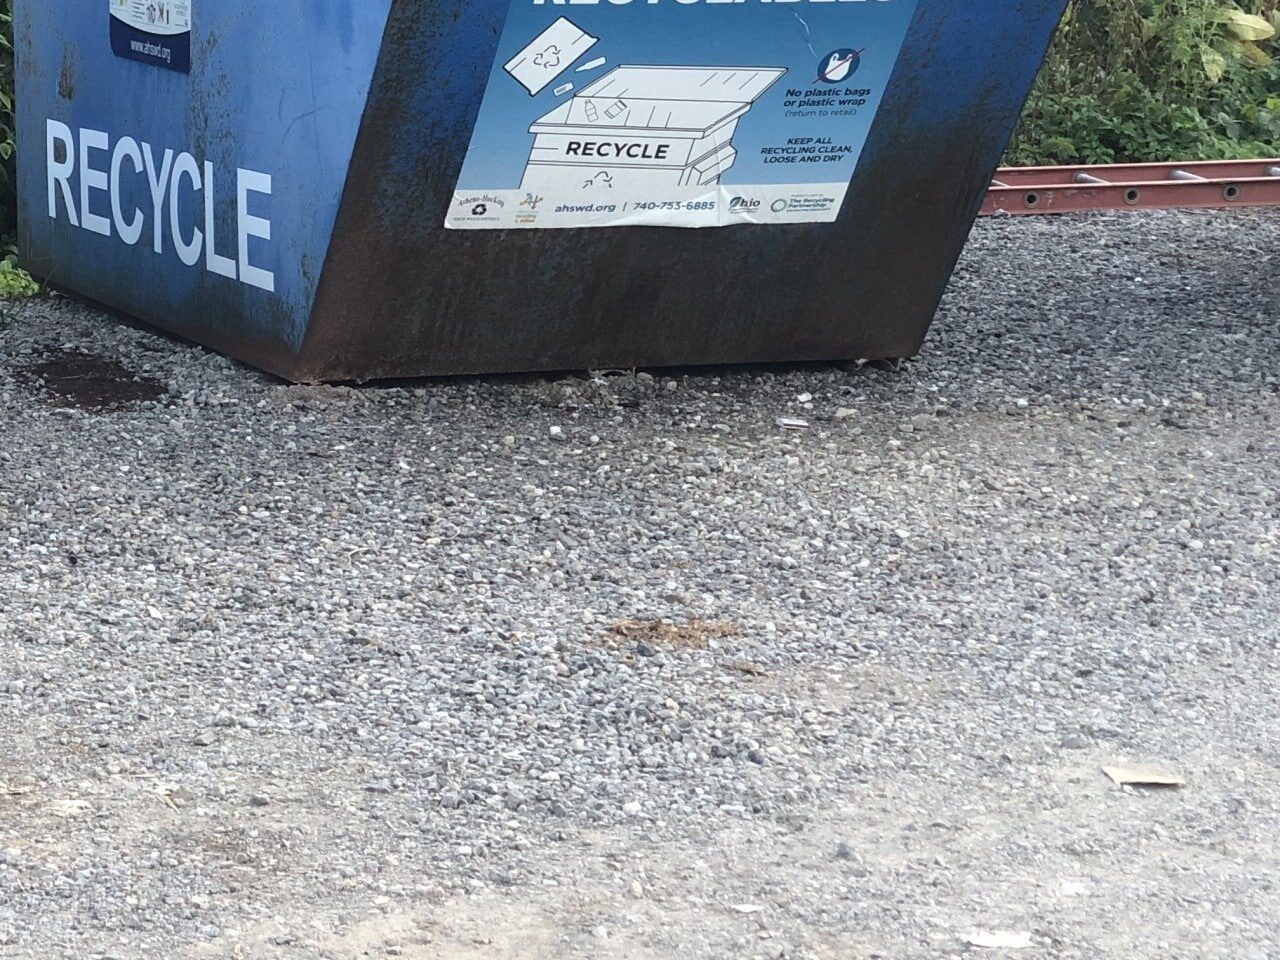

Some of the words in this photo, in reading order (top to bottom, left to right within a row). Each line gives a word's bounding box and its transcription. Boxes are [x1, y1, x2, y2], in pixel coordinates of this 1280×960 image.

[785, 88, 802, 97] No
[804, 88, 842, 98] plastic
[844, 87, 872, 97] bags
[783, 99, 797, 107] or
[797, 98, 836, 108] plastic
[838, 98, 866, 107] wrap
[784, 109, 816, 118] (return
[819, 109, 829, 117] to
[830, 108, 857, 116] retail)
[786, 137, 814, 145] KEEP
[814, 136, 833, 144] ALL
[565, 141, 671, 160] RECYCLE
[760, 146, 816, 155] RECYCLING
[817, 145, 853, 154] CLEAN,
[763, 155, 797, 164] LOOSE
[799, 155, 821, 163] AND
[822, 154, 845, 162] DRY
[46, 118, 275, 293] RECYCLE
[554, 202, 617, 213] ahswd.org
[632, 200, 716, 211] 740-753-6885
